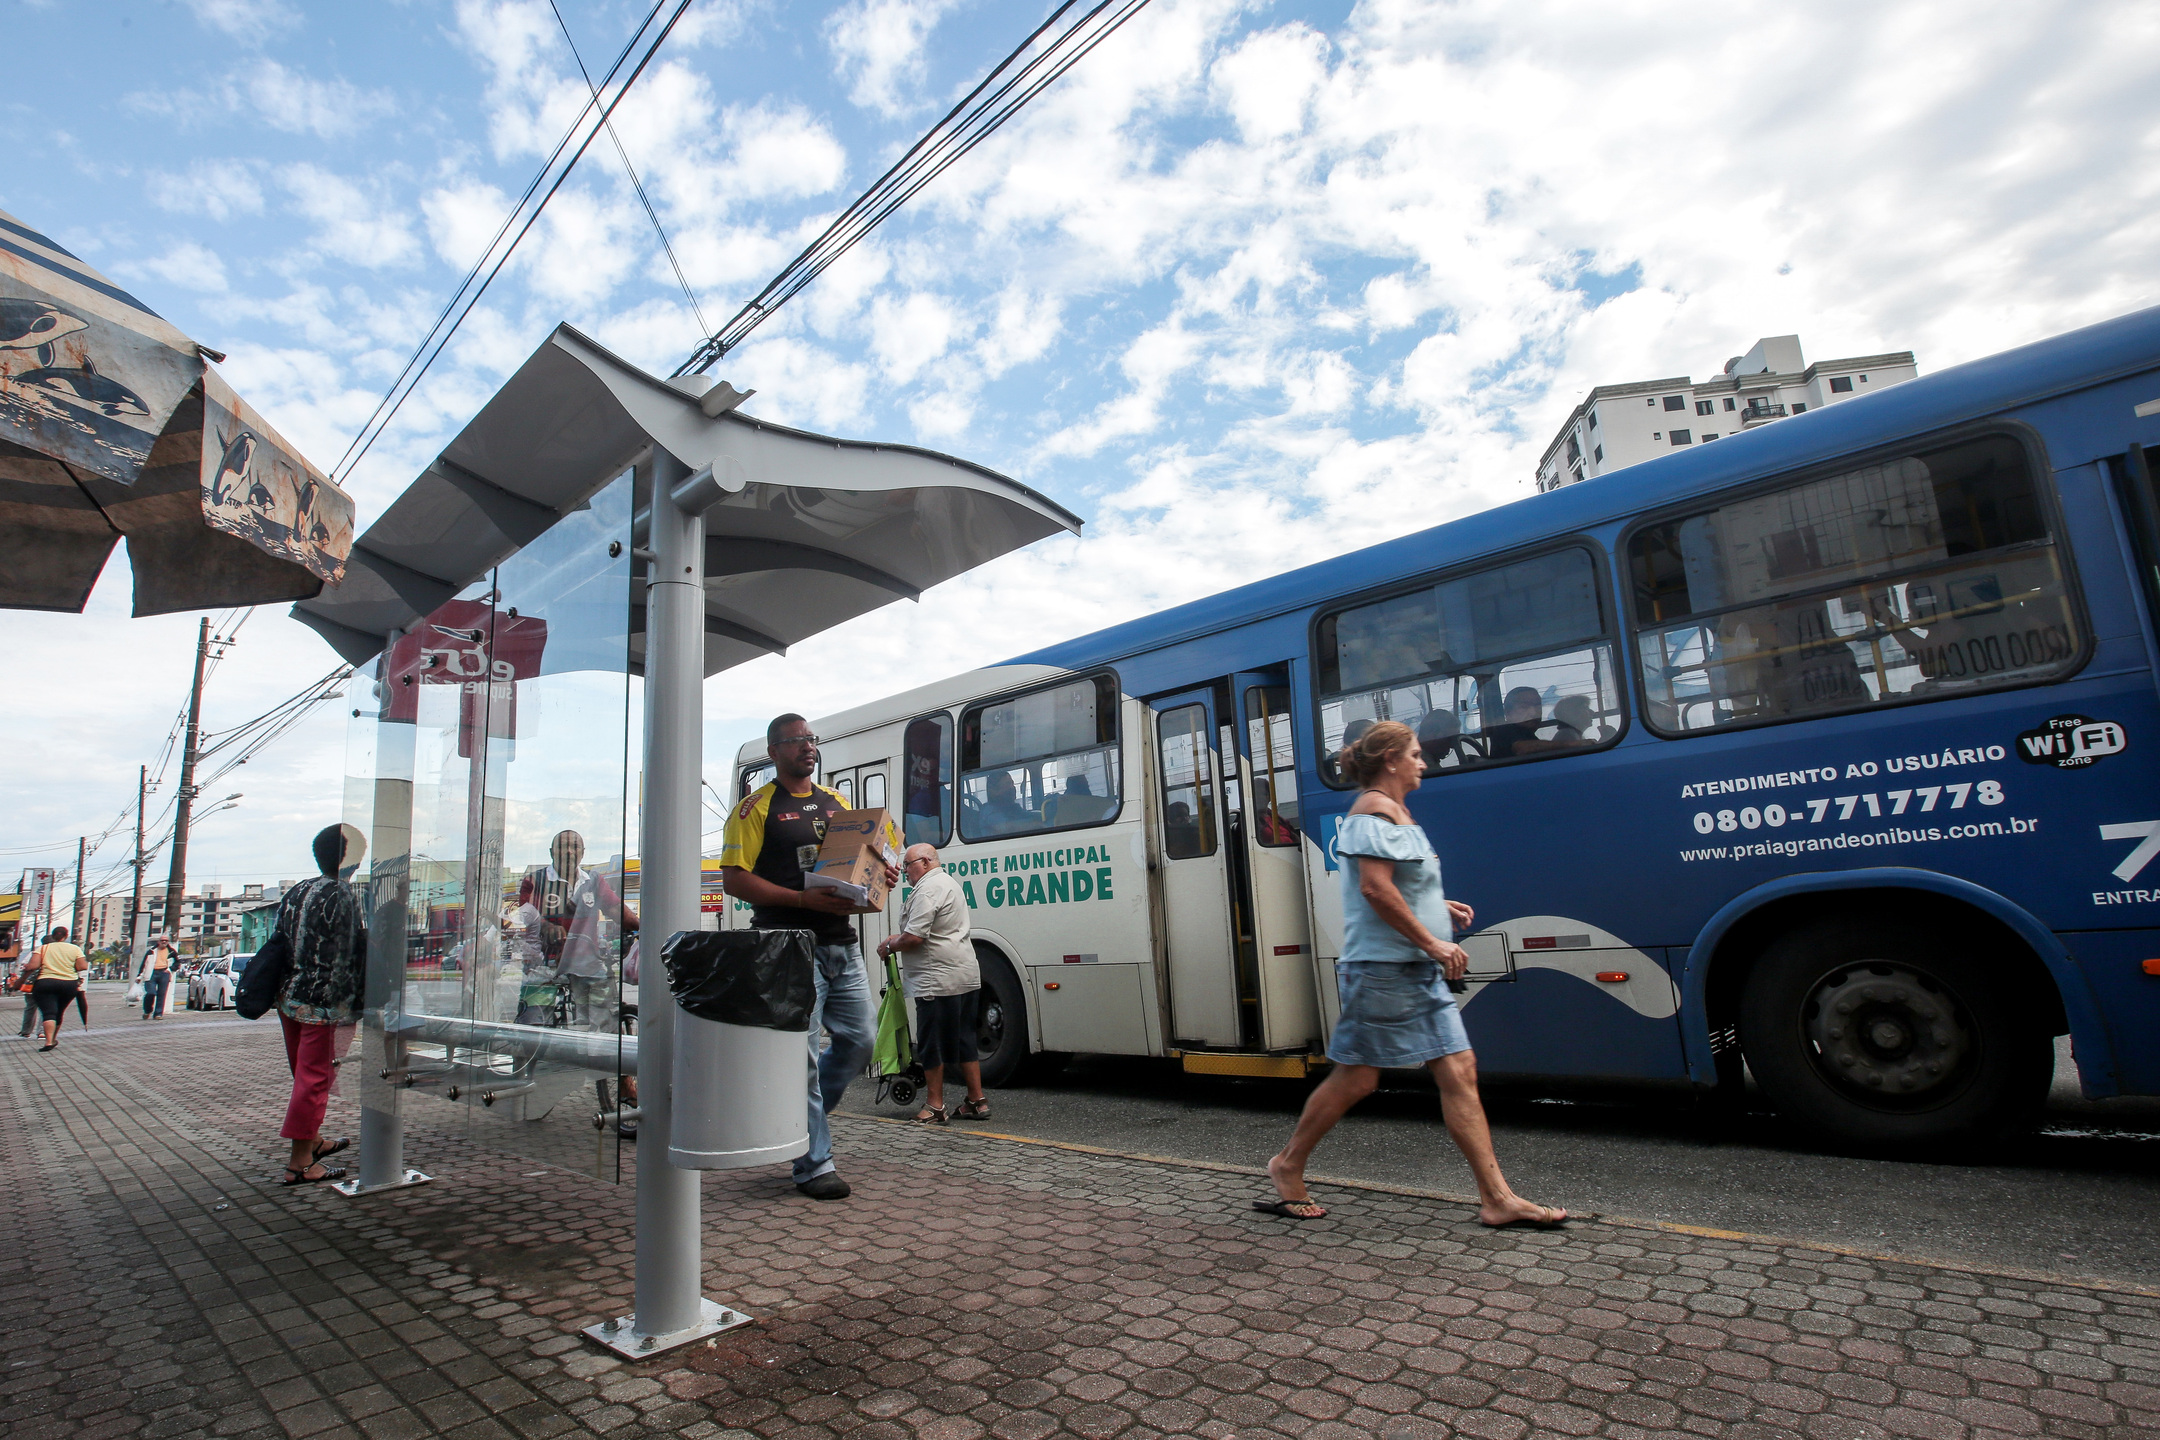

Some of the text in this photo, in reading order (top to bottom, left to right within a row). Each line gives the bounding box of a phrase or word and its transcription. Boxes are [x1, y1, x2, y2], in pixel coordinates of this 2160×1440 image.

[2049, 718, 2082, 730] Free
[1681, 744, 2006, 798] ATENDIMENTO AO USUÁRIO
[2058, 756, 2092, 767] zone
[1693, 780, 2005, 834] 0800-7717778
[1004, 845, 1111, 872] MUNICIPAL
[1680, 816, 2038, 862] www.praiagrandeonibus.com.br
[986, 867, 1114, 908] GRANDE
